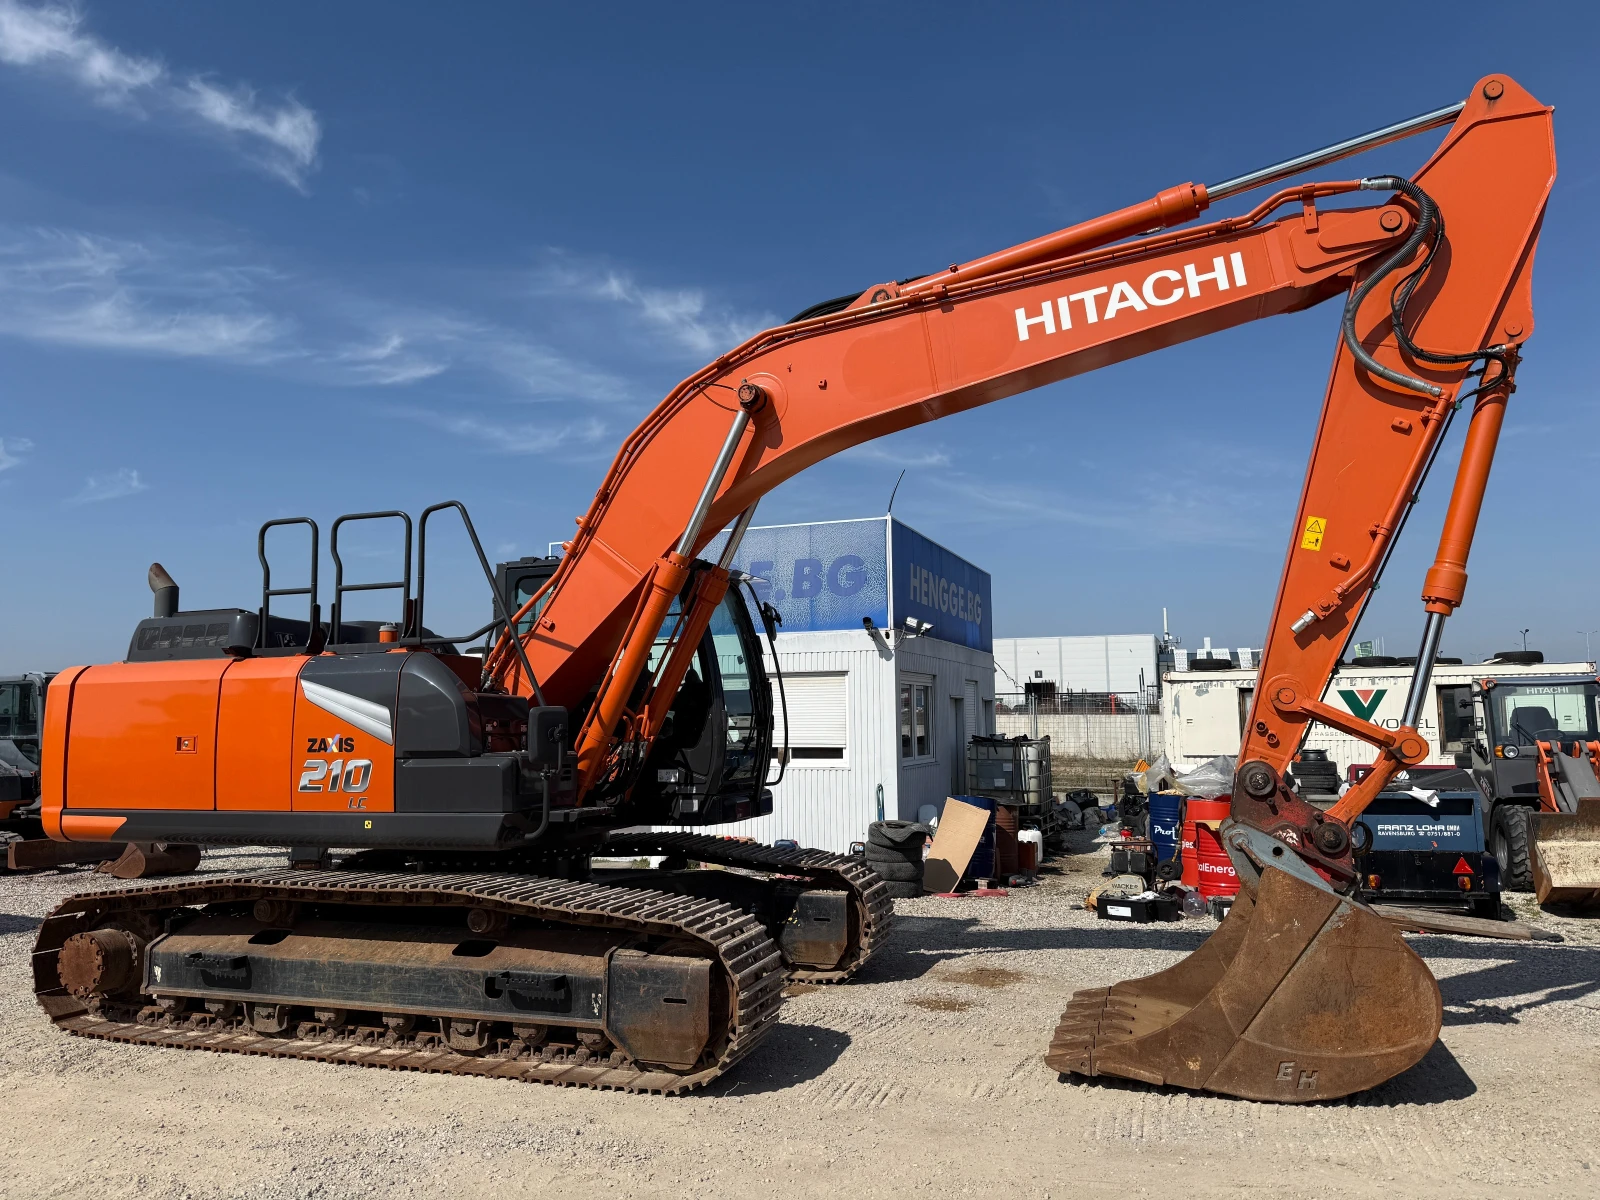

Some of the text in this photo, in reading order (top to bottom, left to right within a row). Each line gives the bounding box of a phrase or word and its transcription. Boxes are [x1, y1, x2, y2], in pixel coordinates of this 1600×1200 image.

[1014, 251, 1248, 342] HITACHI
[729, 555, 867, 602] E.BG
[909, 562, 982, 625] HENGGE.BG
[1526, 686, 1569, 695] HITACHI
[1373, 718, 1436, 729] VOEL
[307, 733, 354, 753] ZAXIS
[298, 758, 373, 793] 210
[347, 796, 368, 809] LC
